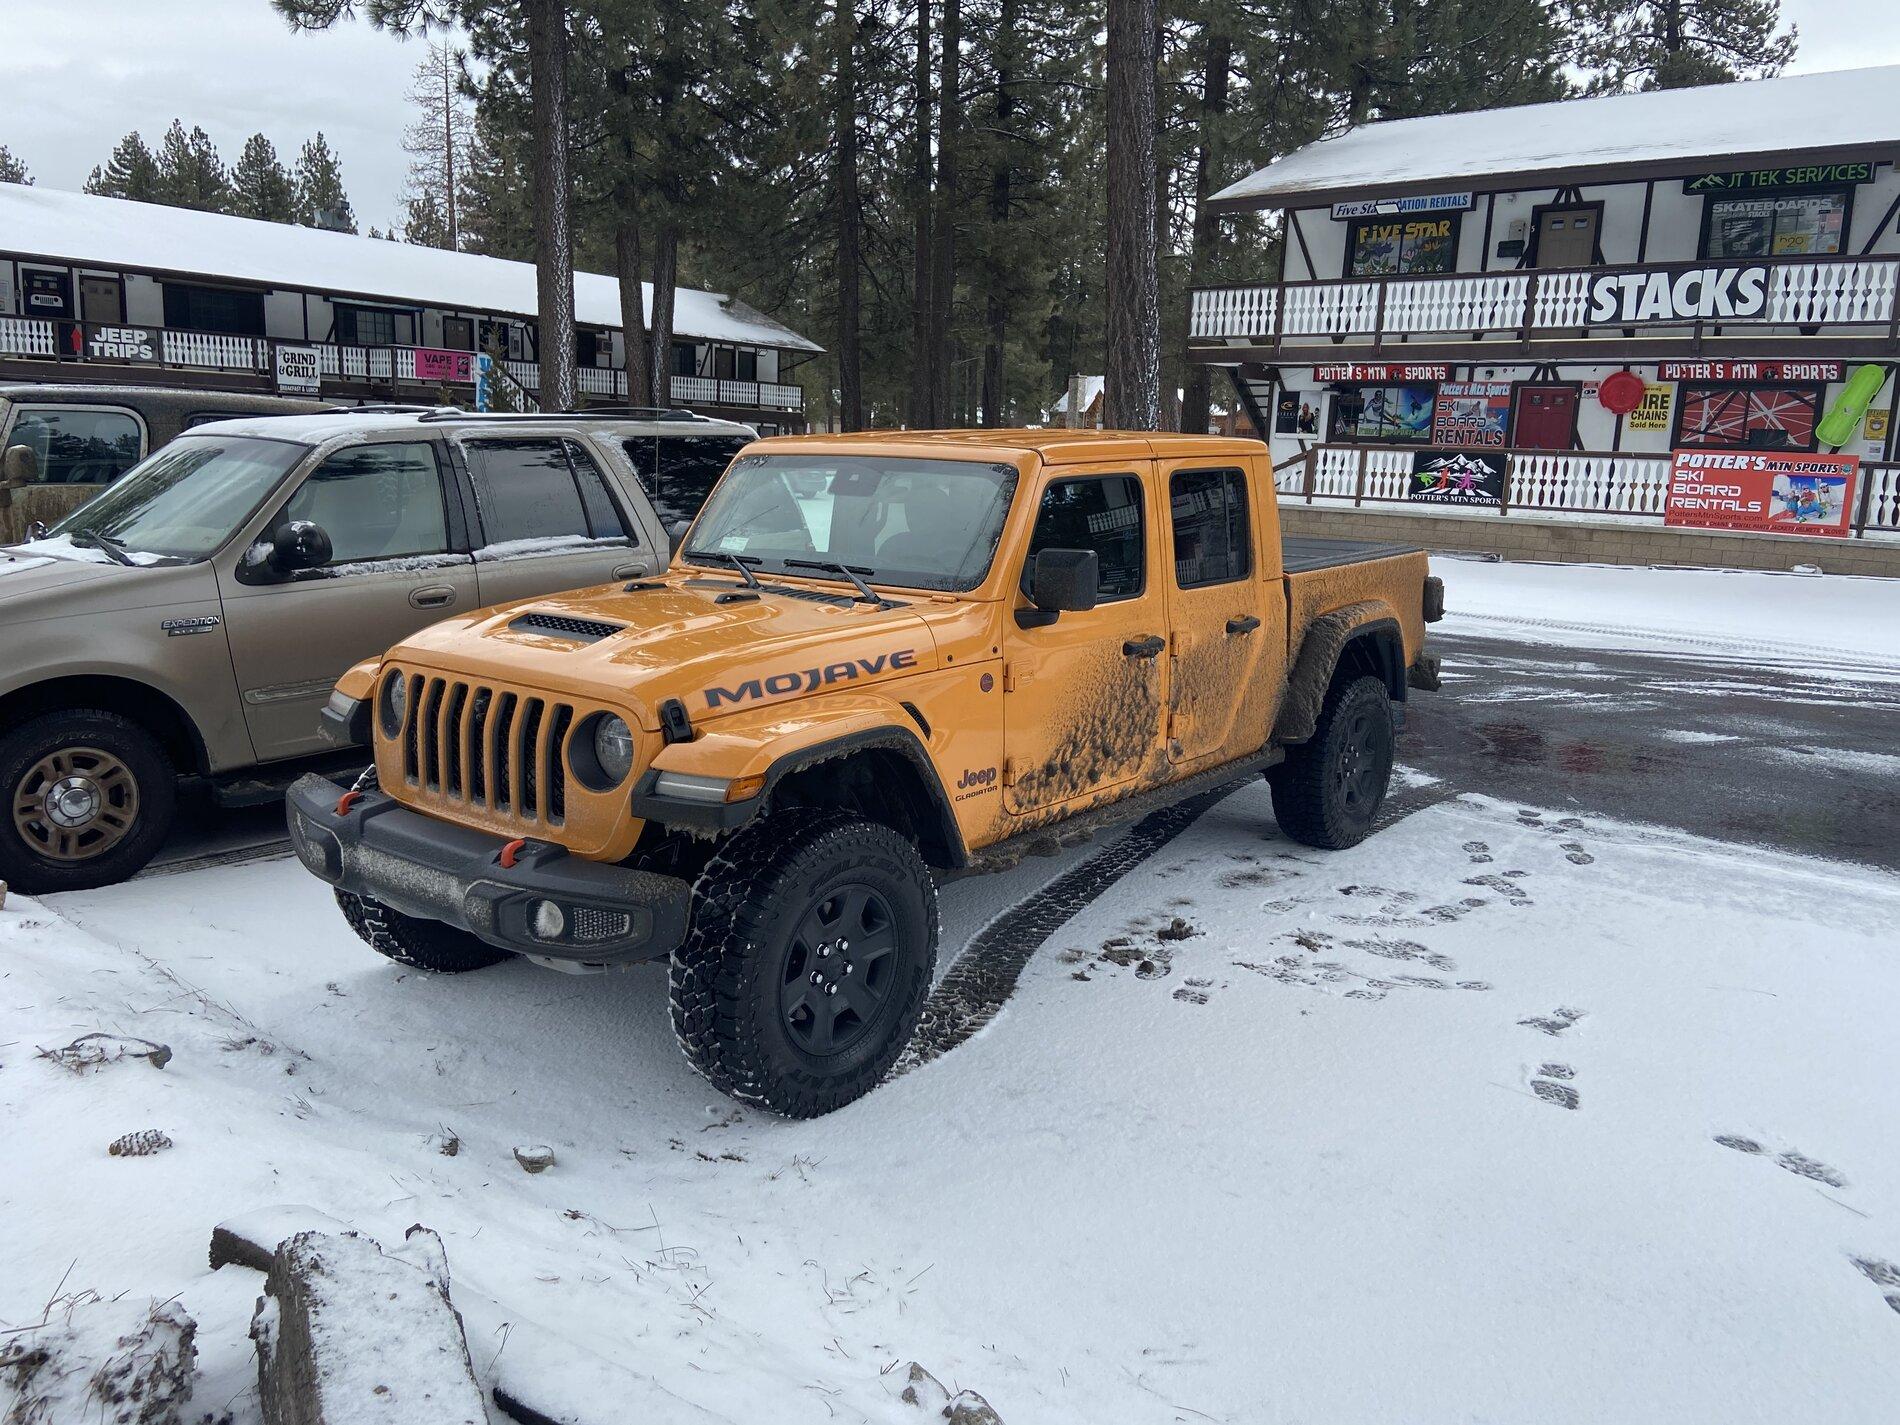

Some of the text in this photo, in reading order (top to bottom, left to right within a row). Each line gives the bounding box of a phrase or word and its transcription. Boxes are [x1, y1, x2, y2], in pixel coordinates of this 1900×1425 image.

[1728, 164, 1868, 188] JT TEK SERVICES
[1336, 204, 1358, 216] Five
[1360, 202, 1378, 215] Sta
[1429, 195, 1468, 209] RENTALS
[1712, 199, 1832, 213] SKATEBOARDS
[1405, 220, 1451, 240] STAR
[1591, 267, 1766, 322] STACKS
[94, 327, 148, 344] JEEP
[90, 341, 153, 360] TRIPS
[283, 352, 316, 366] GRIND
[424, 354, 452, 365] VAPE
[279, 365, 318, 379] & GRILL
[1367, 367, 1387, 380] MTN
[1405, 367, 1446, 380] SPORTS
[1732, 364, 1758, 379] MTN
[1782, 364, 1838, 380] SPORTS
[1468, 383, 1486, 396] Mtn
[1485, 383, 1511, 398] Sports
[1438, 400, 1460, 412] SKI
[1636, 393, 1671, 410] IRE
[1436, 416, 1487, 428] BOARD
[1630, 410, 1668, 421] CHAINS
[1648, 421, 1667, 429] Here
[1434, 428, 1504, 446] RENTALS
[1675, 453, 1840, 474] POTTER'S MTN SPORTS
[1674, 470, 1704, 482] SKI
[1672, 483, 1742, 497] BOARD
[1410, 493, 1449, 502] POTTER'S
[1469, 497, 1501, 505] SPORTS
[1669, 497, 1762, 513] RENTALS
[162, 615, 221, 629] EXPEDITION
[705, 649, 917, 708] MOJAVE
[957, 766, 997, 790] Jeep
[955, 784, 998, 802] GLADIATOR
